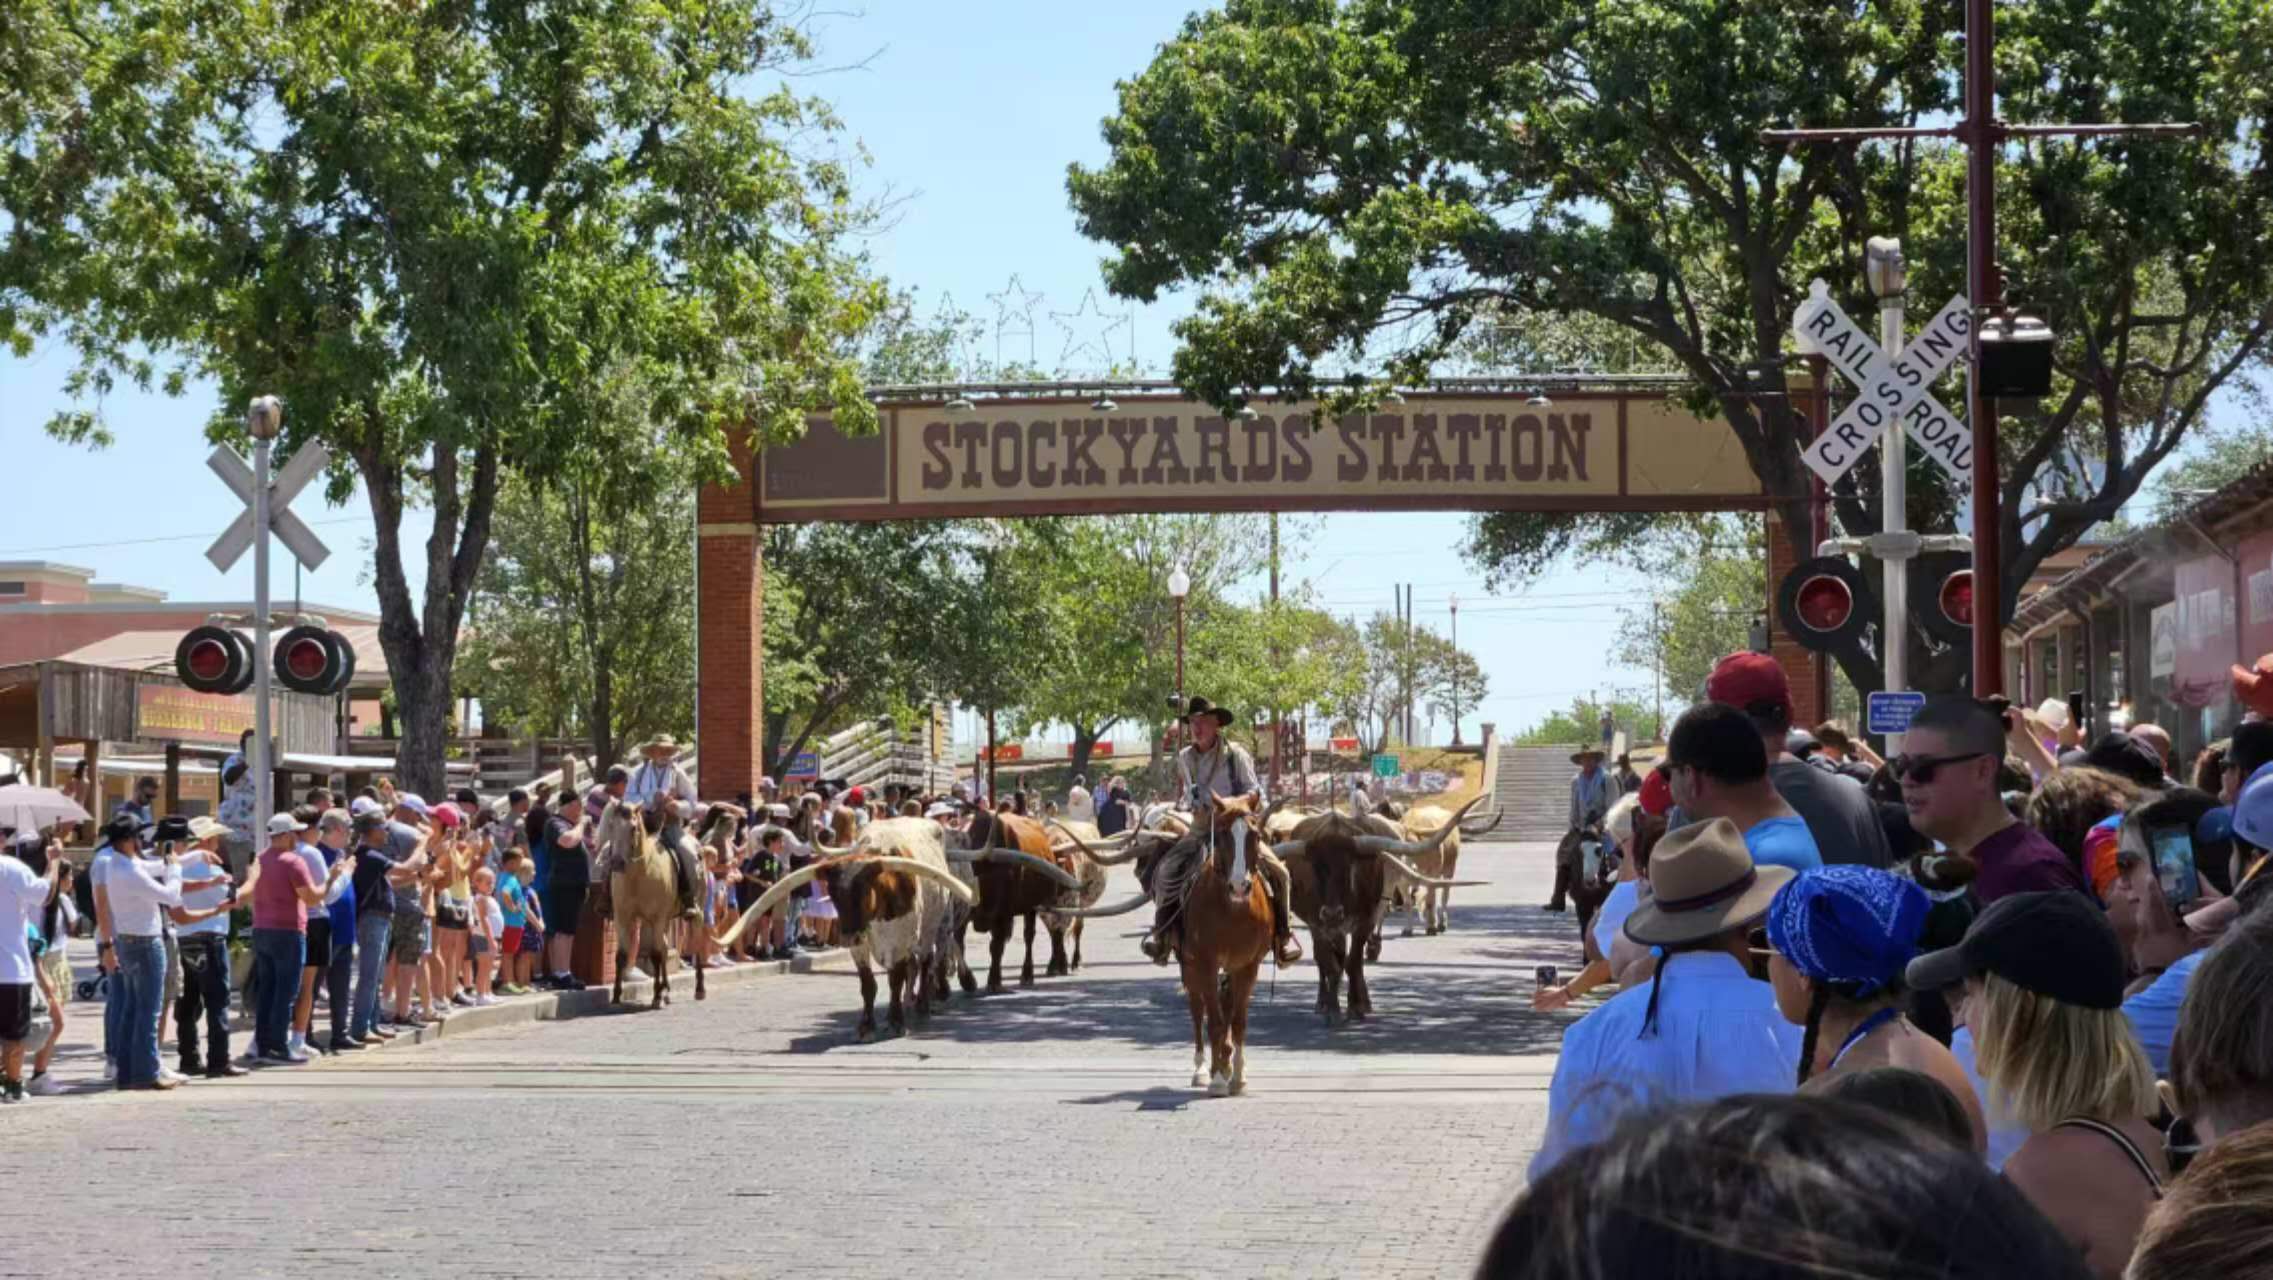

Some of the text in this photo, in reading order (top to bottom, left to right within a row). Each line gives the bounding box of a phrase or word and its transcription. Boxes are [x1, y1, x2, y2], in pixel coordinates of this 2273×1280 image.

[1808, 310, 1874, 380] RAIL
[1819, 310, 1969, 467] CROSSING
[921, 413, 1592, 489] STOCKYARDS STATION
